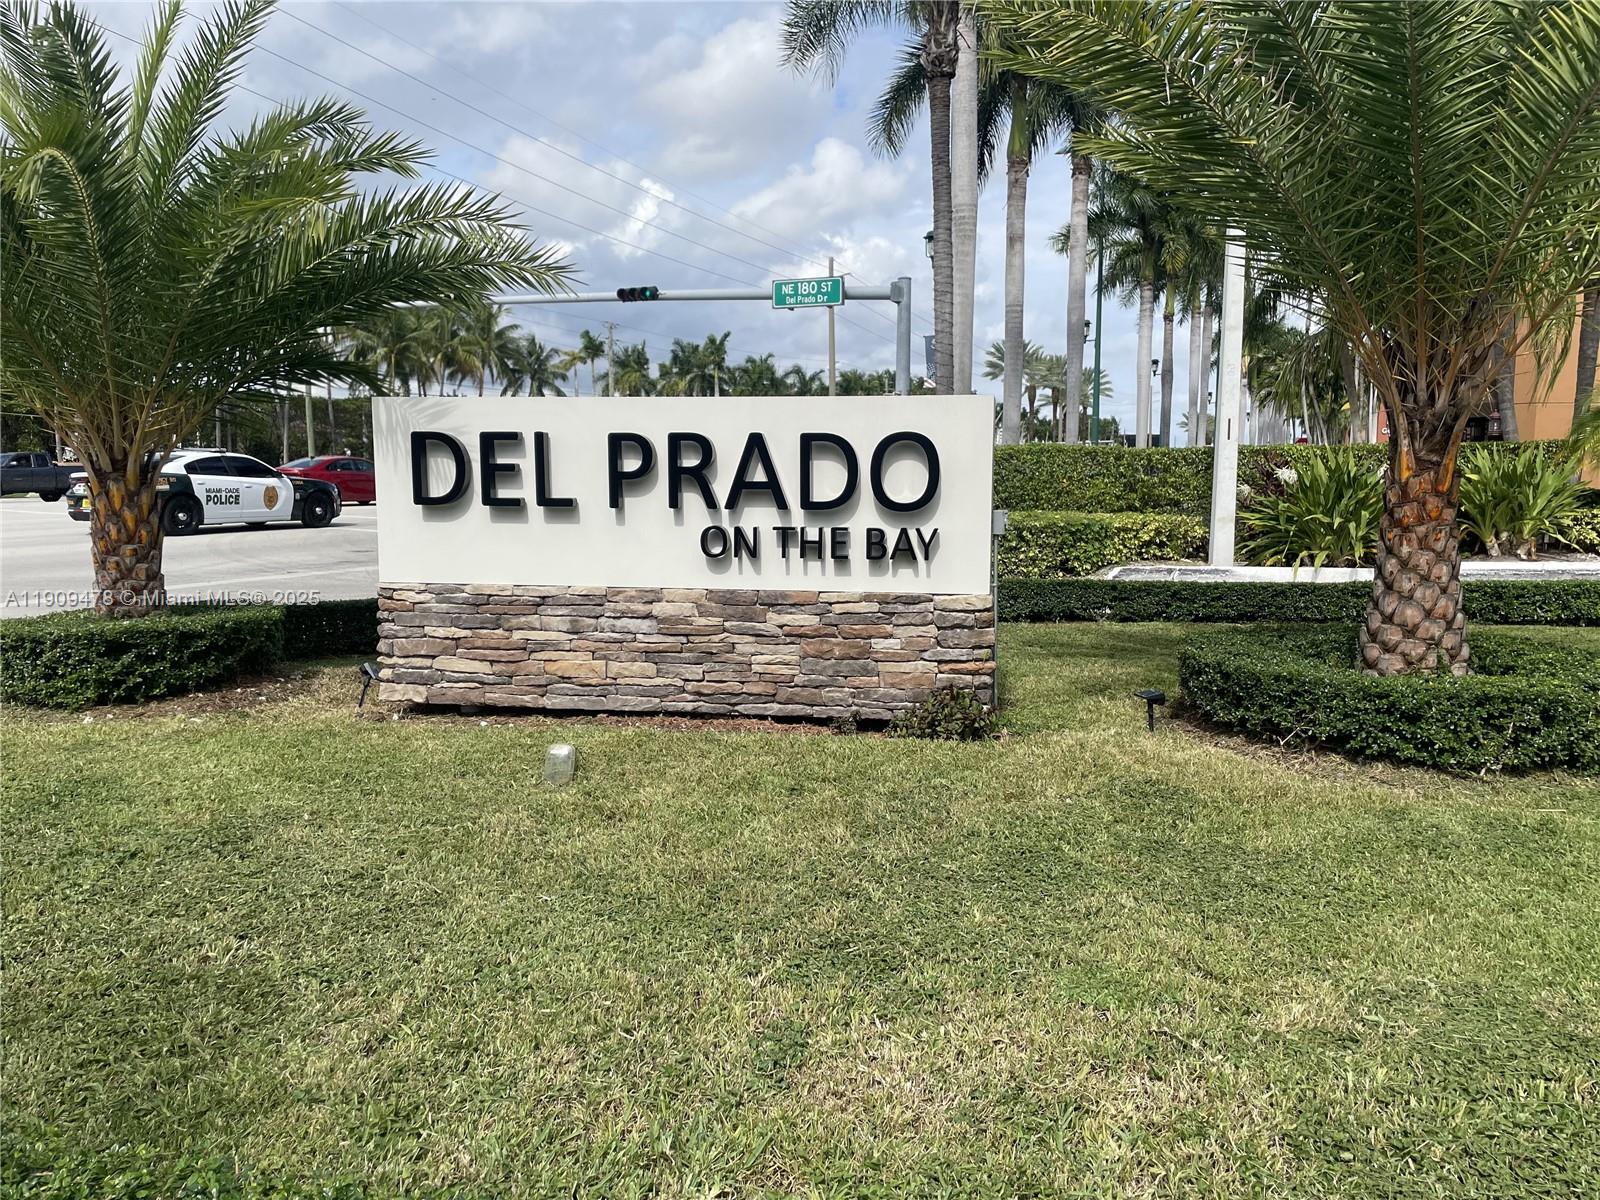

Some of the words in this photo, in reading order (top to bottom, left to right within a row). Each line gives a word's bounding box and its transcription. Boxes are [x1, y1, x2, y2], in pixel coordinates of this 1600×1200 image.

[782, 284, 794, 295] NE
[797, 282, 817, 294] 180
[820, 281, 832, 292] ST
[786, 296, 796, 304] Del
[797, 295, 815, 303] Prado
[410, 431, 577, 507] DEL
[608, 431, 940, 512] PRADO
[206, 495, 240, 505] POLICE
[701, 525, 758, 559] ON
[773, 526, 849, 560] THE
[867, 527, 939, 562] BAY
